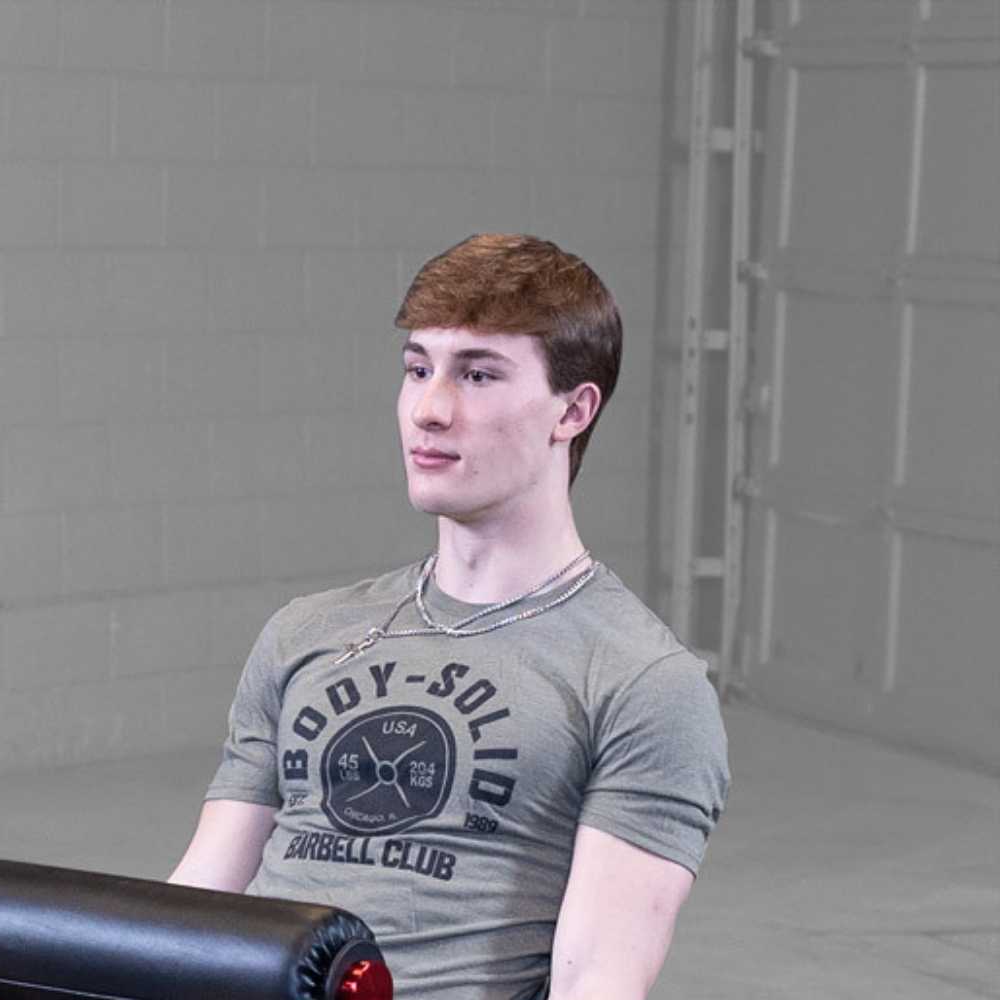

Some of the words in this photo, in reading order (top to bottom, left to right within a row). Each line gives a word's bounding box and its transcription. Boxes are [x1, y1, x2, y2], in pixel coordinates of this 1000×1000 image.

[283, 661, 518, 807] BODY-SOLID
[382, 721, 418, 738] USA
[338, 753, 360, 771] 45
[410, 774, 433, 788] KGS
[464, 812, 499, 834] 1989
[283, 831, 375, 866] BARBELL
[381, 839, 457, 881] CLUB
